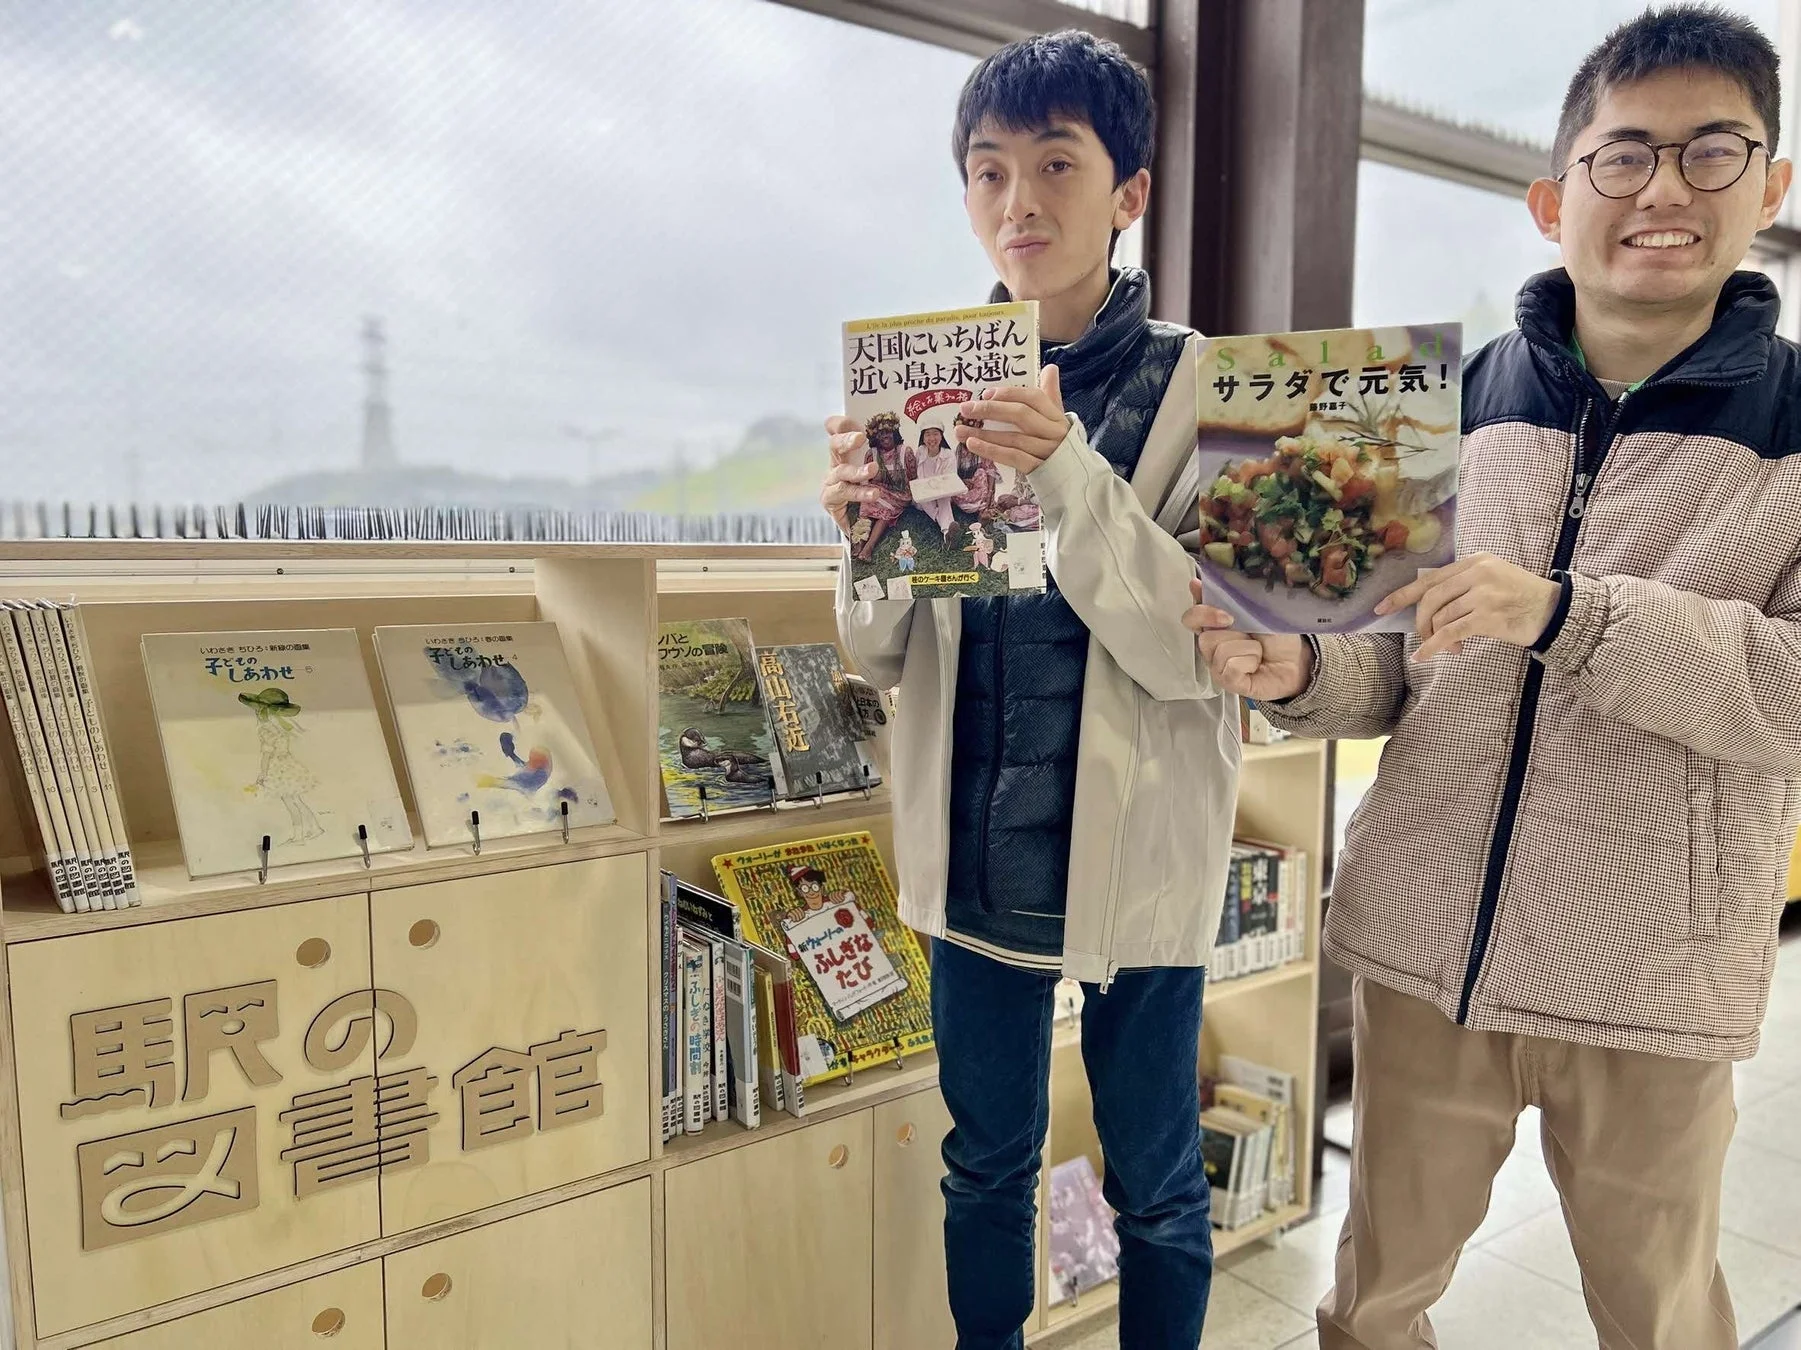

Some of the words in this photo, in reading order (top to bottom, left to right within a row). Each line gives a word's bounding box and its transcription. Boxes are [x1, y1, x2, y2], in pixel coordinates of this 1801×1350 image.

[849, 319, 1028, 365] 天国にいちばん
[1213, 363, 1447, 402] サラダで元気!
[200, 646, 235, 654] いわさき
[425, 637, 455, 645] いわさき
[429, 646, 474, 665] 子どもの
[450, 654, 508, 670] しあわせ
[205, 657, 257, 676] 子どもの
[228, 665, 295, 683] しあわせ
[760, 650, 810, 752] 高山右近
[814, 933, 873, 975] ふしぎな
[835, 955, 874, 990] たび
